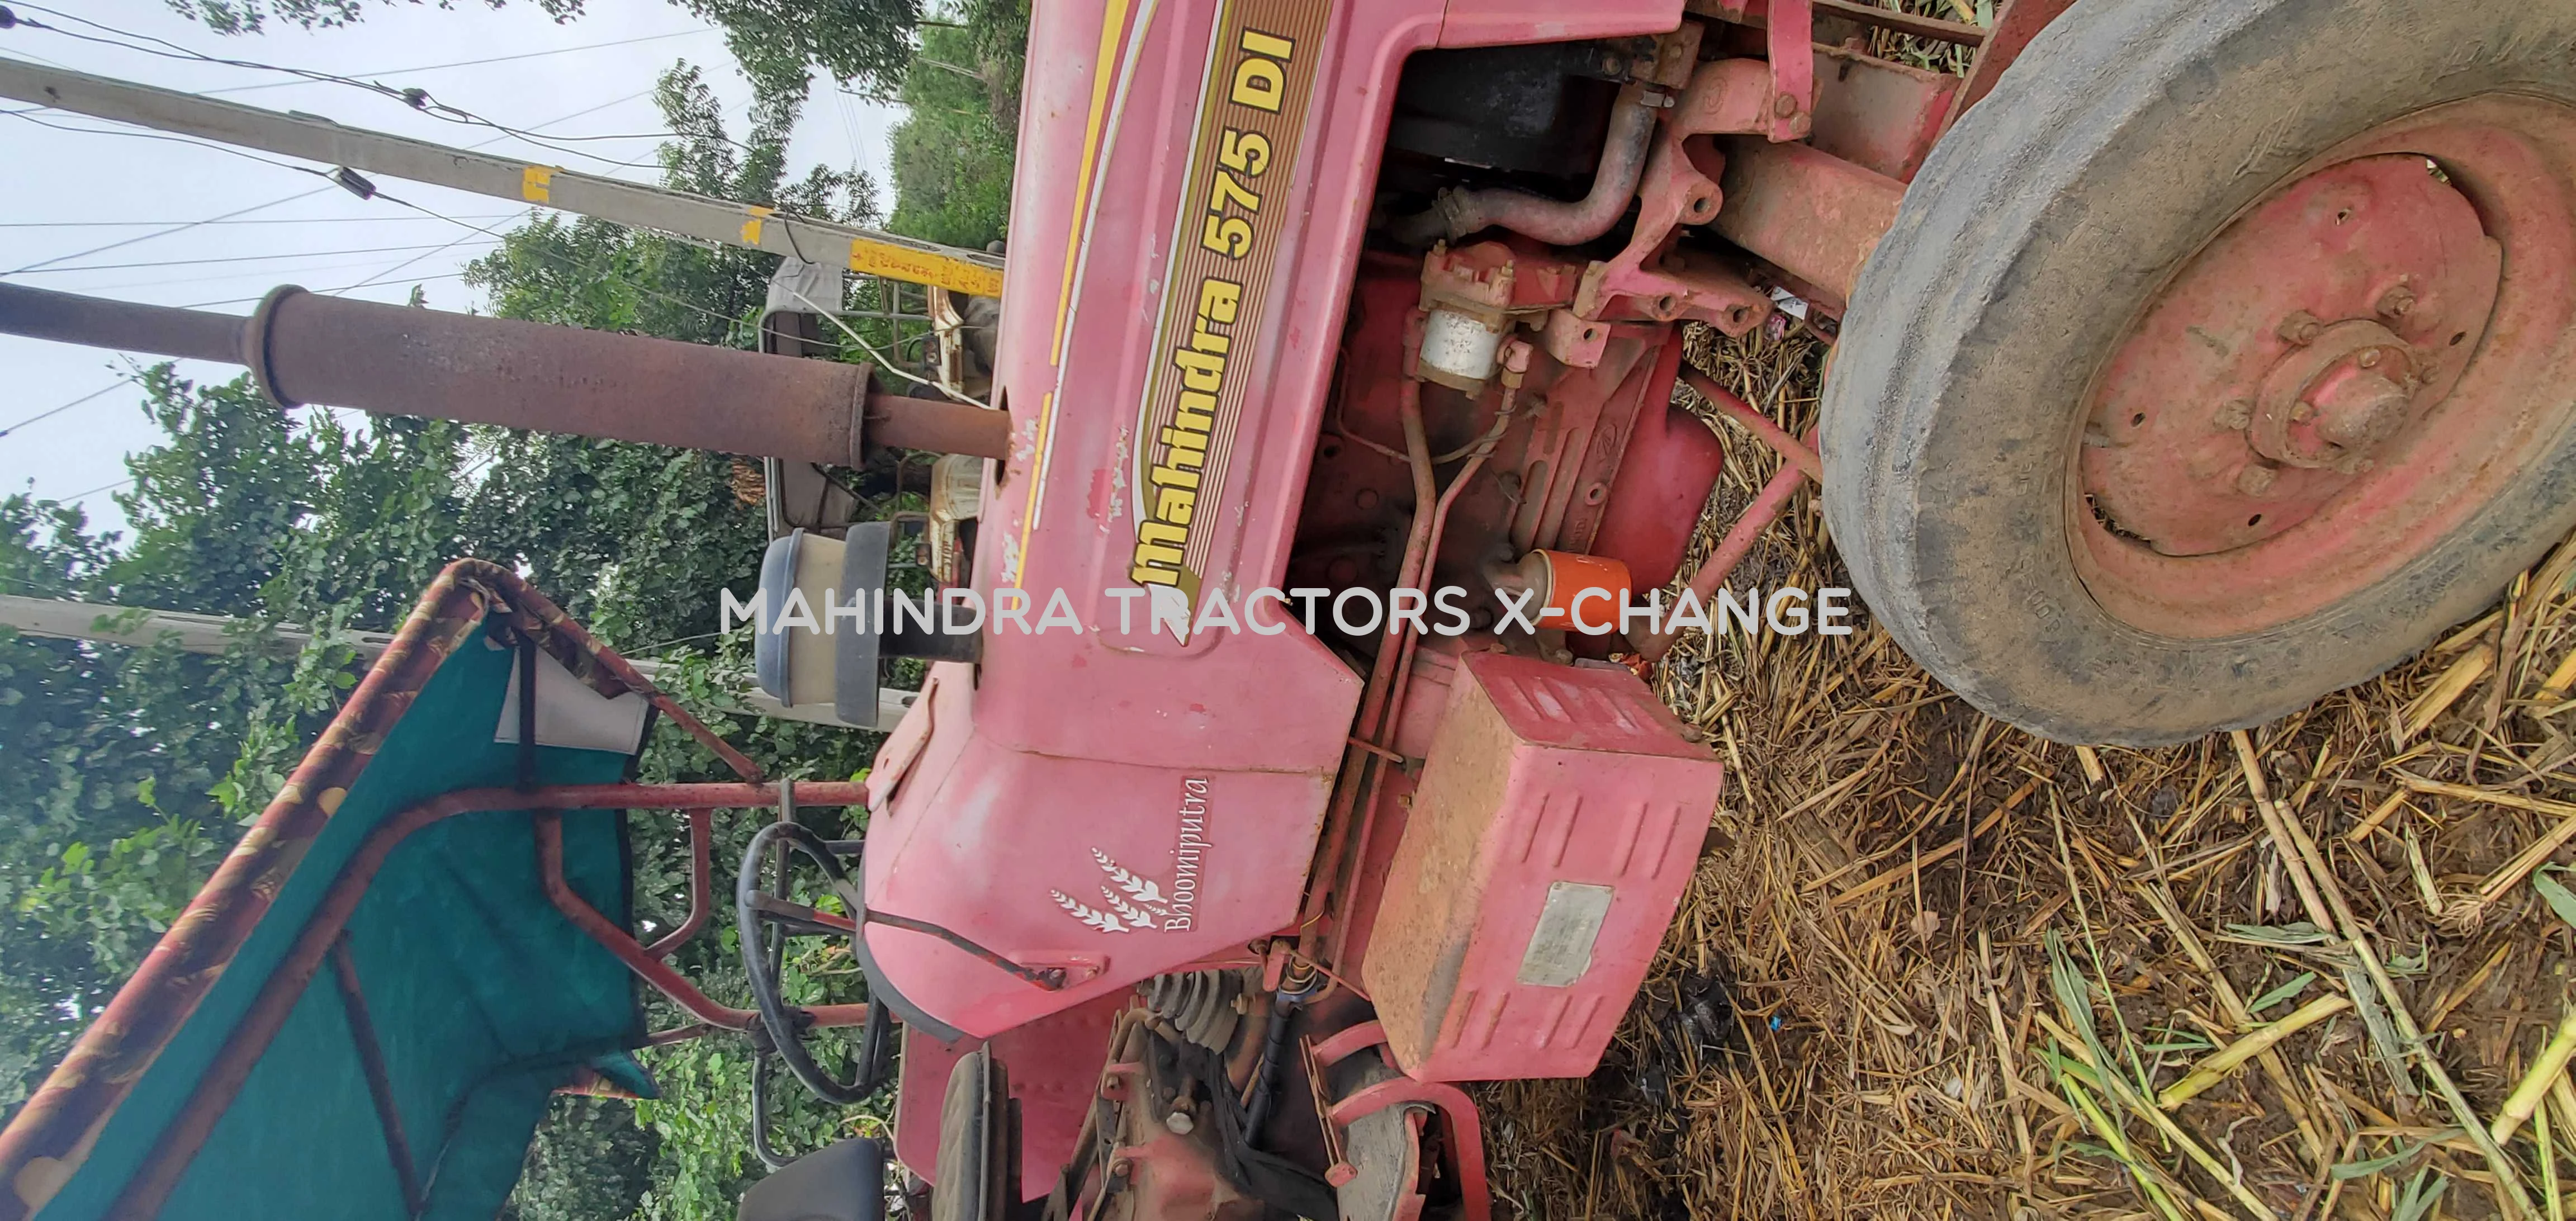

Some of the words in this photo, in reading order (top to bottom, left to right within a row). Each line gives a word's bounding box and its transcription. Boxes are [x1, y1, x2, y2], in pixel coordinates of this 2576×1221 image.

[1228, 26, 1296, 115] DI
[1200, 125, 1273, 261] 575
[1129, 277, 1244, 587] Mahindra
[1164, 776, 1213, 933] Bhoomiputra
